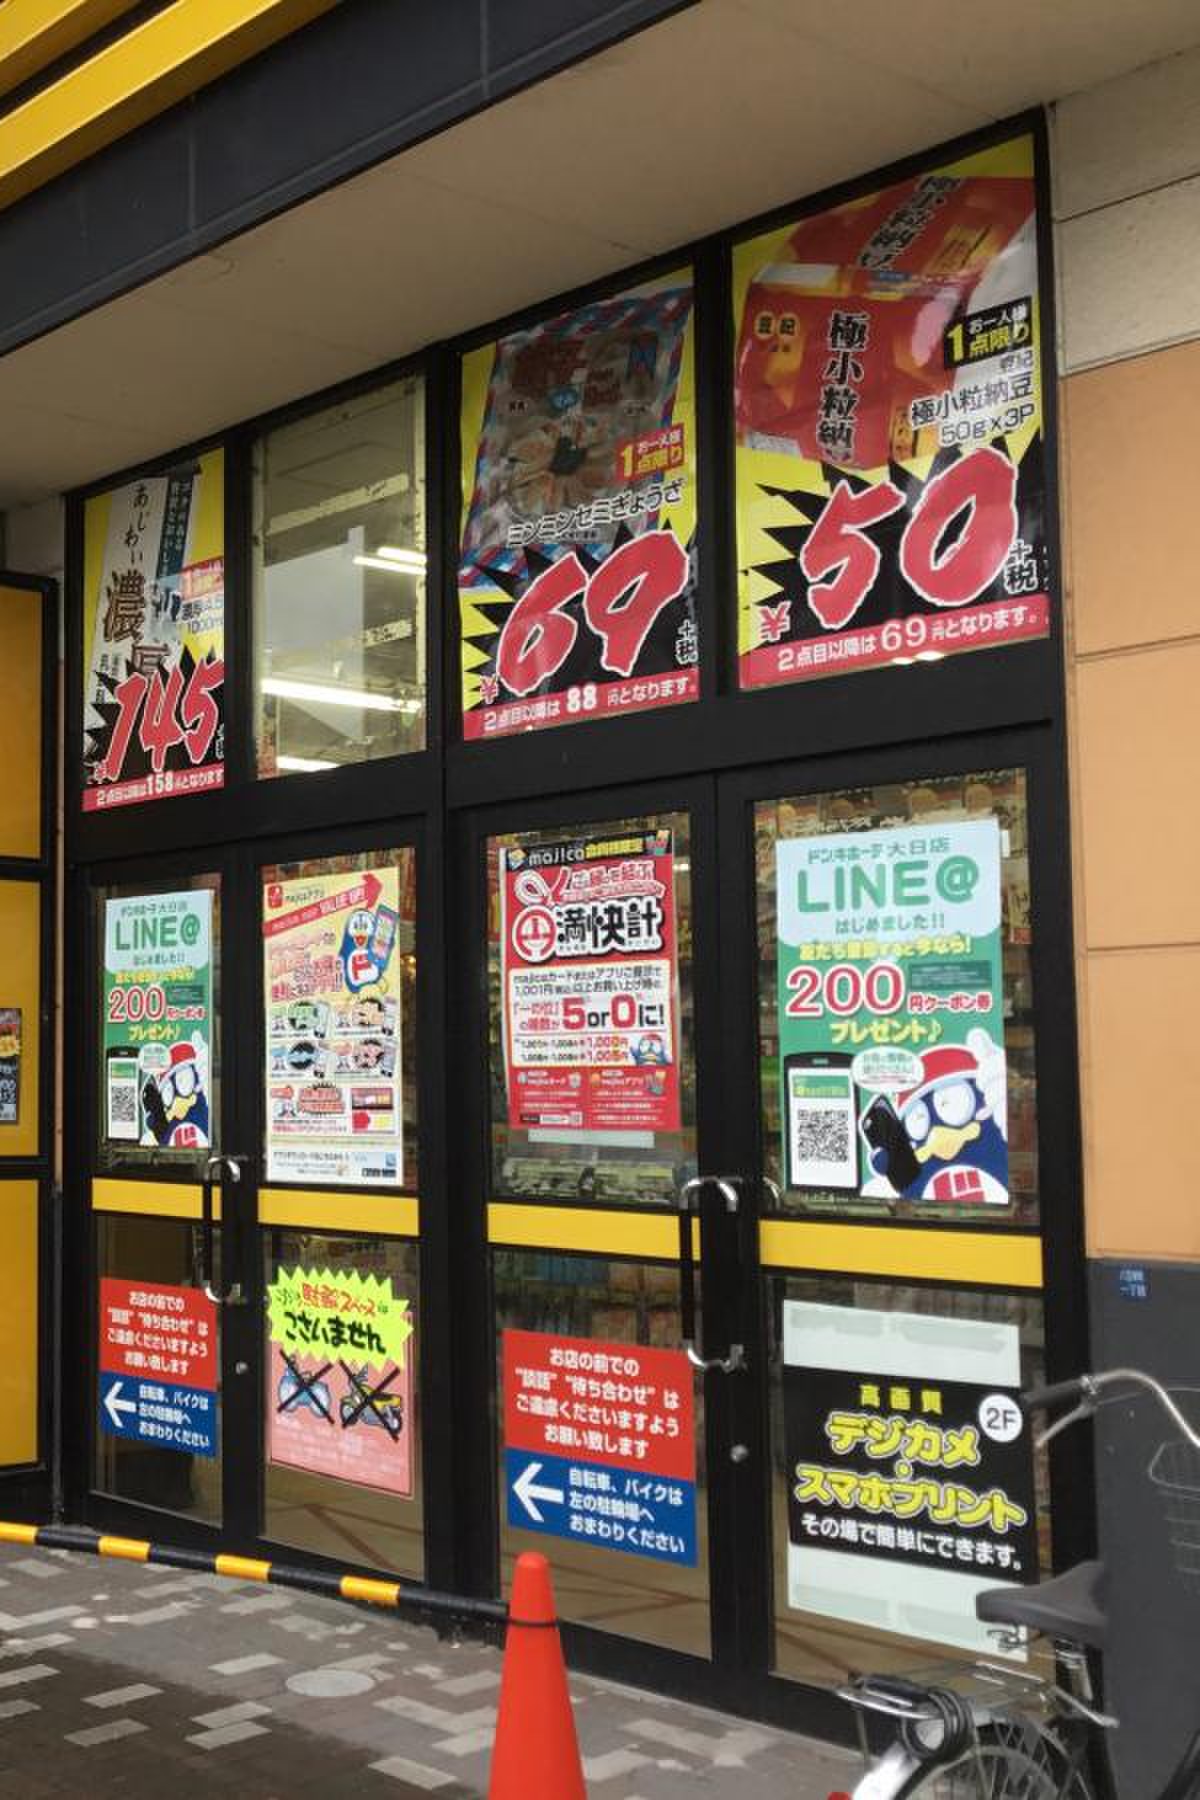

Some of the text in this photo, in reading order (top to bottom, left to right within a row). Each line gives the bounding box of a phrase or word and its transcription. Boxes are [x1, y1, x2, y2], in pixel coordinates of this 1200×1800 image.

[911, 371, 1033, 427] 極小粒納豆
[496, 530, 689, 697] 69
[107, 657, 224, 781] 145
[797, 855, 980, 913] LINE@
[116, 913, 201, 951] LINE@
[826, 1411, 981, 1468] デジカメ
[985, 1406, 1017, 1432] 2F
[795, 1463, 1028, 1533] スマホプリント
[801, 1512, 1023, 1572] その場で簡単にできます。
